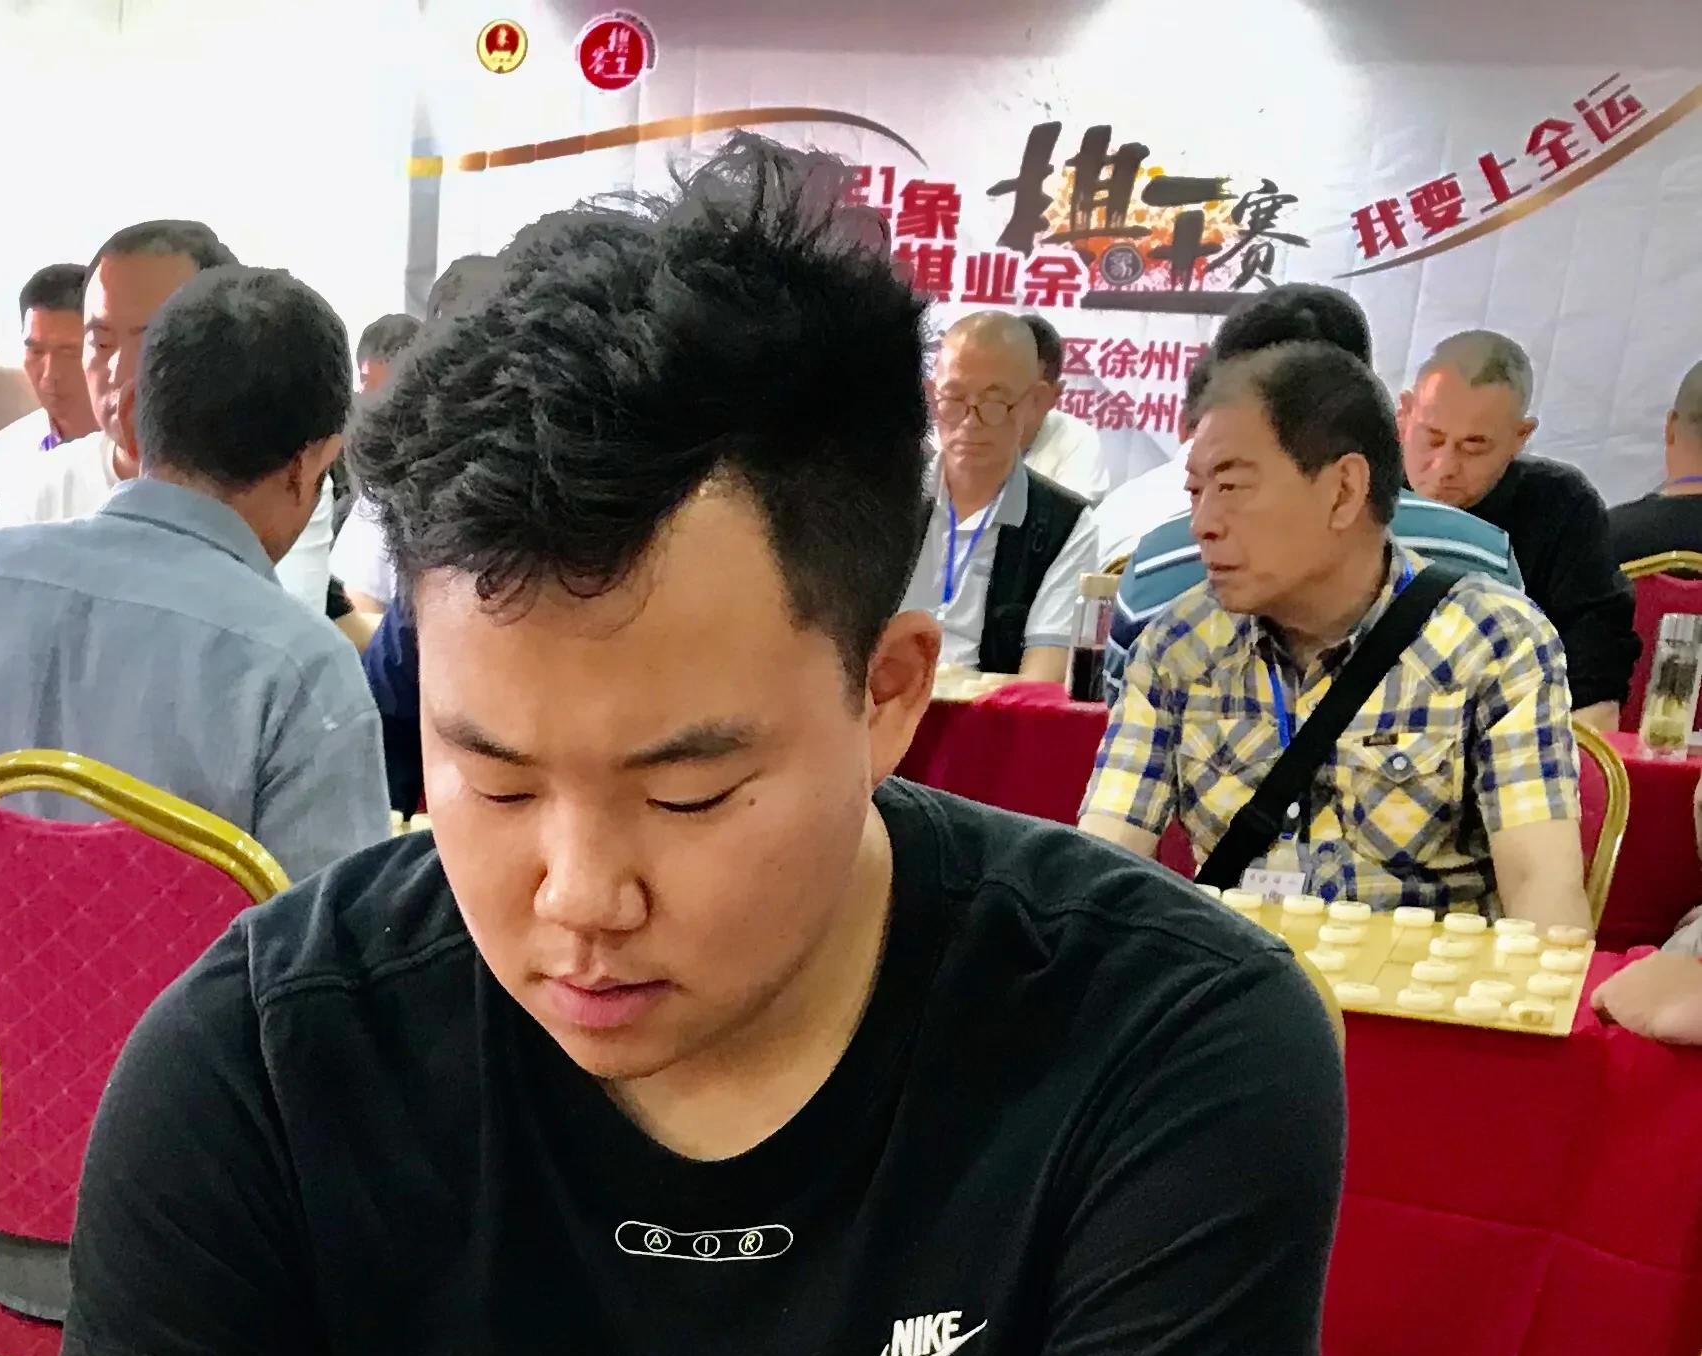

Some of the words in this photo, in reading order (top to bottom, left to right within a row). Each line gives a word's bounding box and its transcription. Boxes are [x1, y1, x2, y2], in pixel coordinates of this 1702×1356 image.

[1351, 72, 1648, 260] 我要上全运
